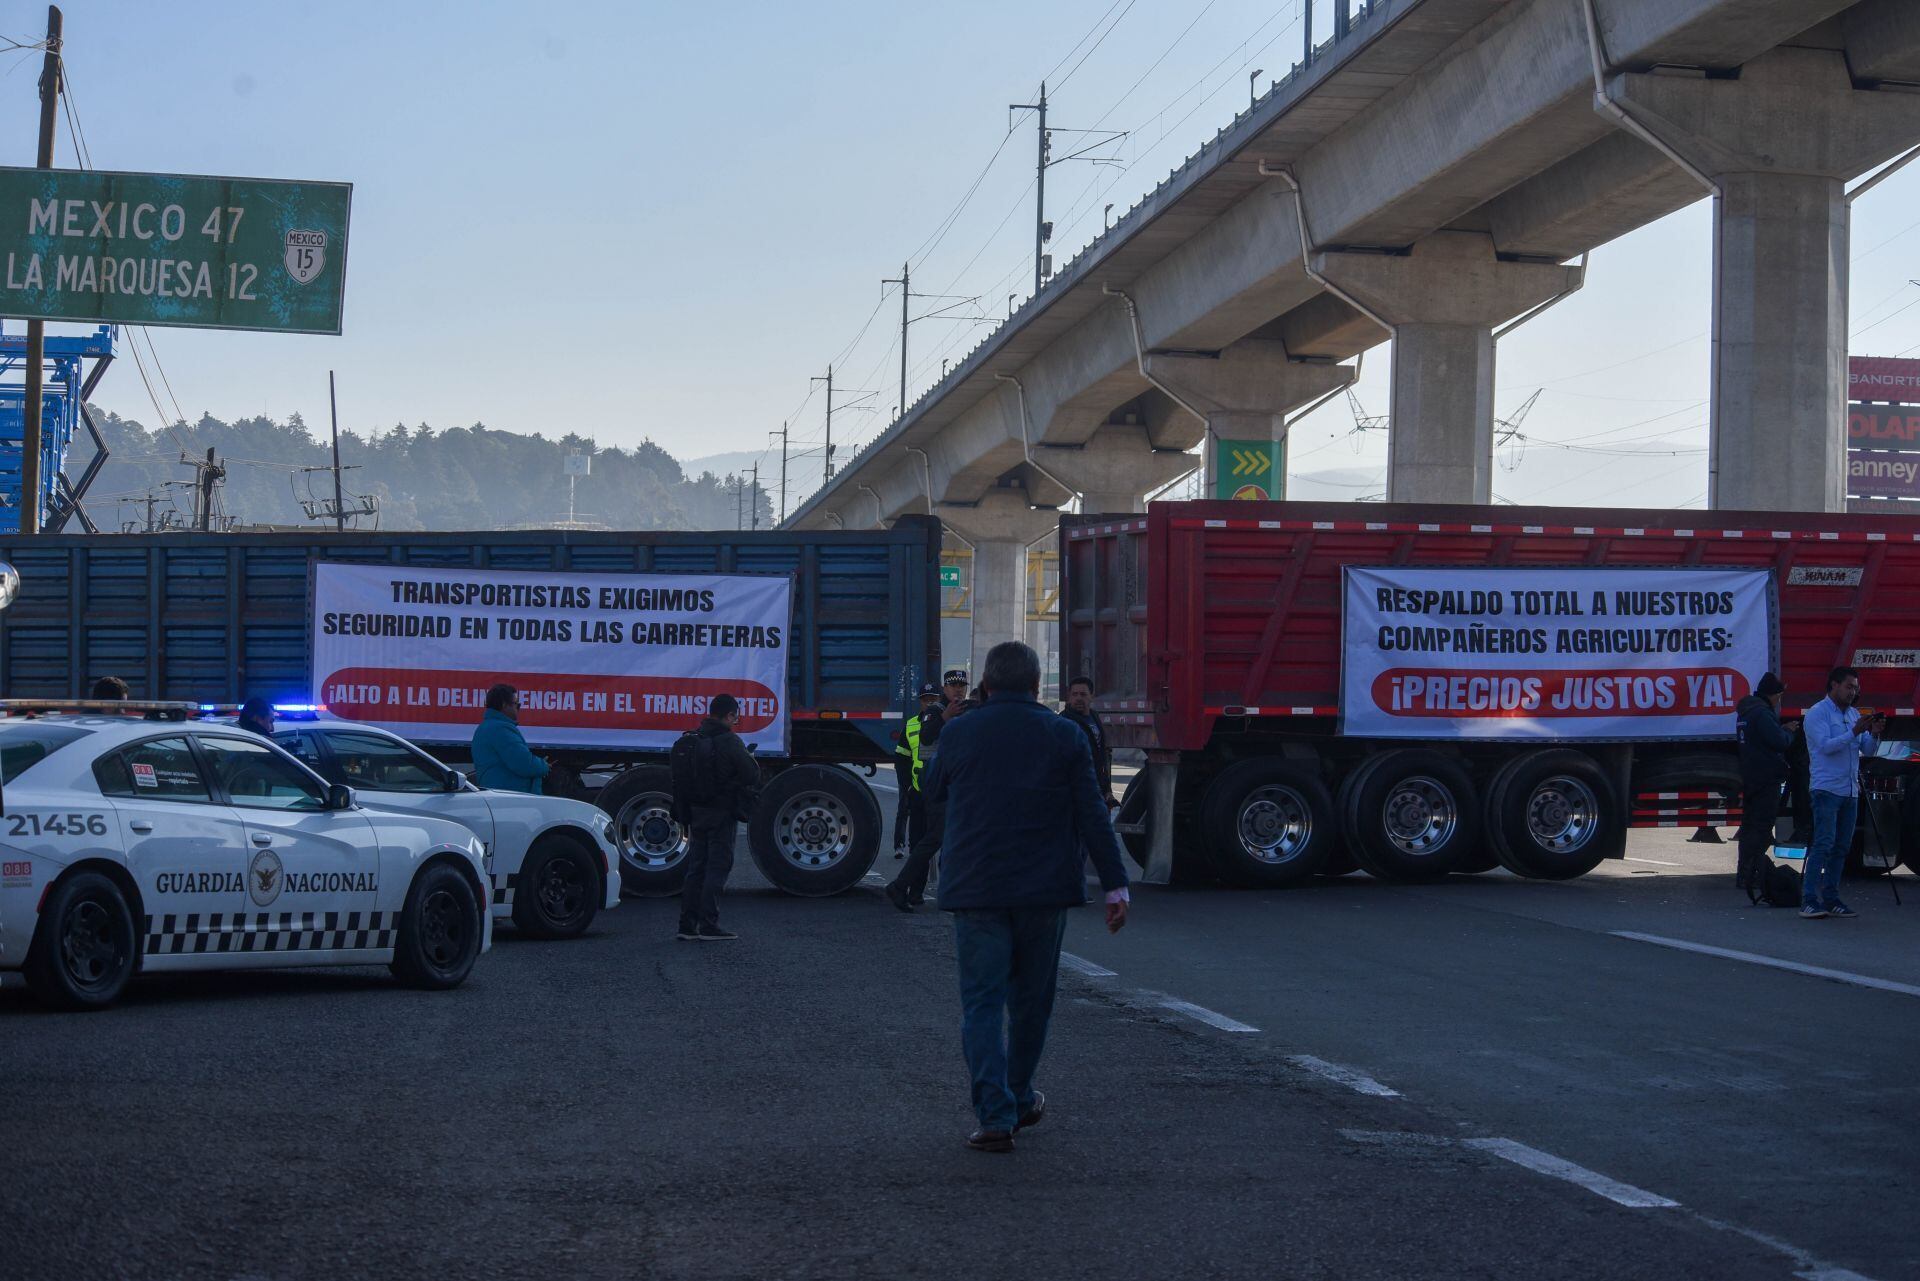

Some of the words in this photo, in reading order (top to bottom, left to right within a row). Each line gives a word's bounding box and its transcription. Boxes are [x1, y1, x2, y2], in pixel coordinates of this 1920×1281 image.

[29, 198, 186, 241] MEXICO
[201, 206, 245, 243] 47
[288, 232, 324, 246] MEXICO
[296, 248, 314, 269] 15
[6, 252, 44, 291] LA
[55, 254, 213, 299] MARQUESA
[228, 262, 259, 300] 12
[299, 270, 307, 278] D
[390, 580, 591, 609] TRANSPORTISTAS
[599, 587, 715, 612] EXIGIMOS
[1376, 587, 1503, 616] RESPALDO
[1511, 590, 1584, 616] TOTAL
[1592, 590, 1607, 616] A
[1616, 591, 1734, 616] NUESTROS
[323, 612, 451, 638] SEGURIDAD
[459, 617, 488, 639] EN
[497, 618, 572, 642] TODAS
[580, 620, 623, 643] LAS
[631, 622, 781, 649] CARRETERAS
[1377, 622, 1548, 654] COMPAÑEROS
[1555, 627, 1733, 654] AGRICULTORES:
[1862, 654, 1915, 664] TRAILERS
[329, 684, 381, 705] ¡ALTO
[387, 686, 400, 705] A
[407, 686, 431, 706] LA
[437, 687, 576, 711] DELINENCIA
[582, 692, 607, 712] EN
[614, 693, 636, 713] EL
[1391, 675, 1543, 711] ¡PRECIOS
[1551, 675, 1676, 709] JUSTOS
[1684, 674, 1734, 708] YA!
[6, 814, 107, 837] 21456
[4, 863, 31, 874] 088
[156, 872, 245, 894] GUARDIA
[284, 871, 378, 893] NACIONAL
